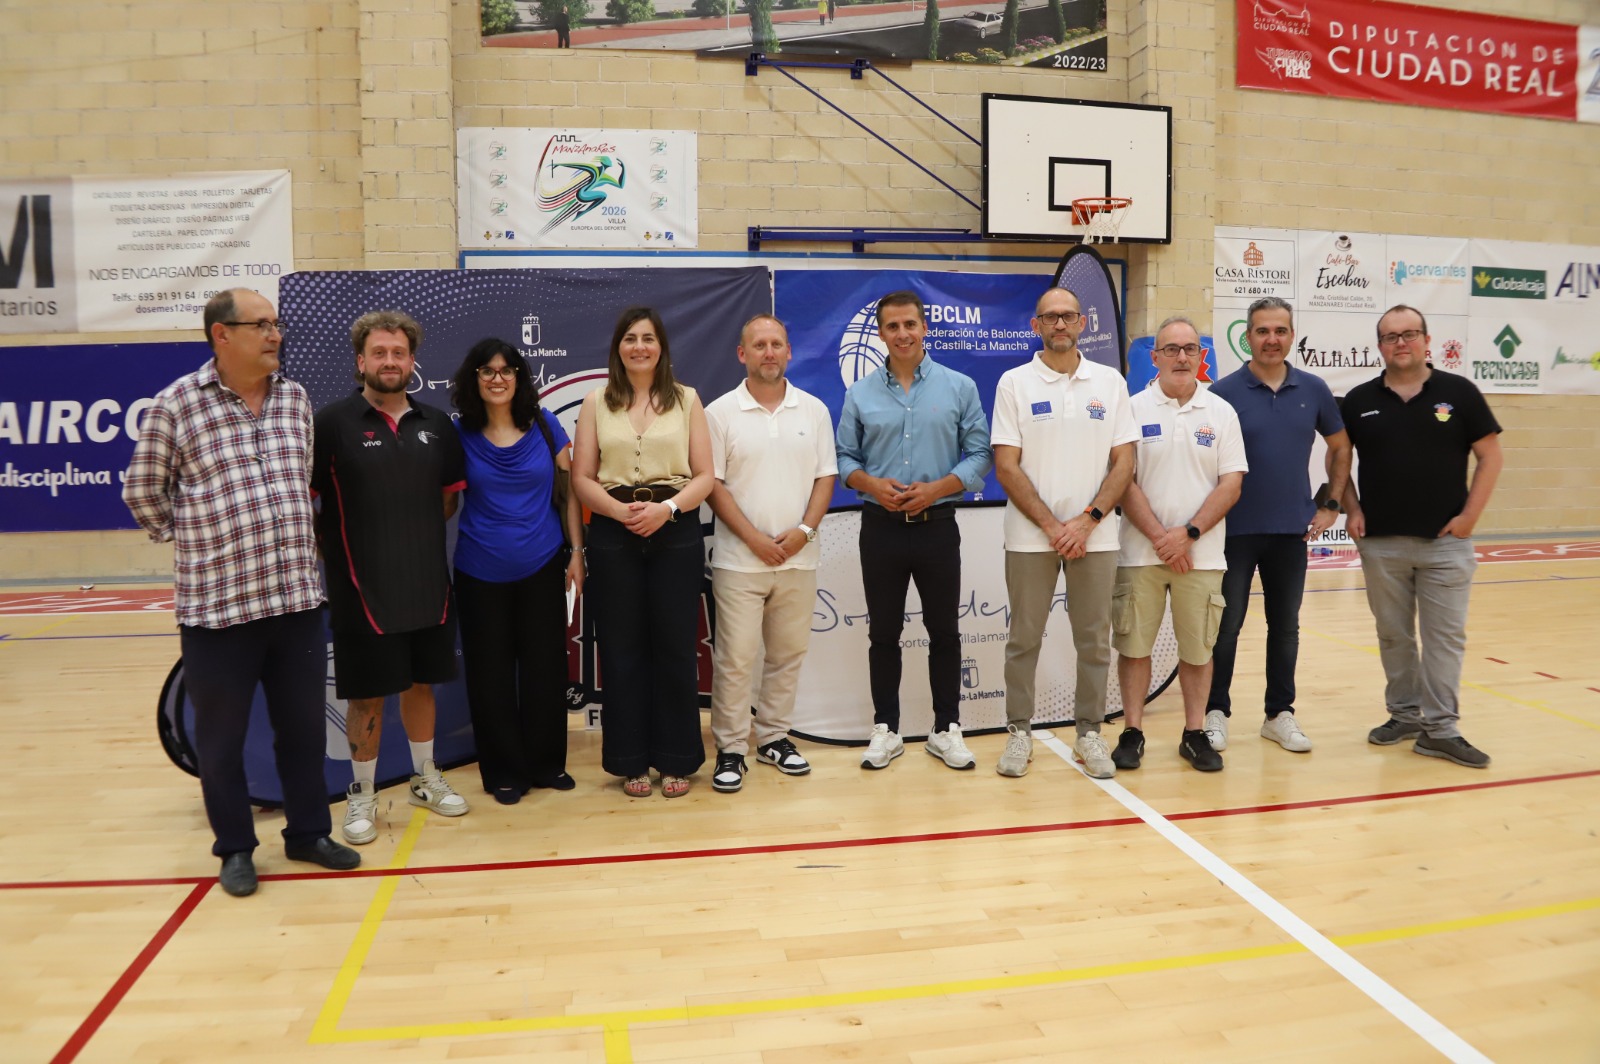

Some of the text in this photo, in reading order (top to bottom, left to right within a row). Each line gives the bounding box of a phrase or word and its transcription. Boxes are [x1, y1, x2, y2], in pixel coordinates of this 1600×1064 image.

[1254, 22, 1310, 36] CIUDAD REAL
[1532, 45, 1565, 66] DE
[1054, 54, 1107, 71] 2022/23
[1274, 57, 1312, 70] CIUDAD
[1285, 67, 1312, 80] REAL
[1327, 46, 1474, 87] CIUDAD
[1484, 62, 1565, 98] REAL
[136, 190, 169, 198] REVISTAS
[173, 189, 198, 197] LIBROS
[202, 188, 235, 197] FOLLETOS
[240, 187, 273, 196] TARJETAS
[229, 201, 255, 209] DIGITAL
[601, 206, 627, 216] 2026
[235, 213, 250, 221] WEB
[177, 229, 199, 237] PAPEL
[200, 227, 234, 236] CONTINUO
[155, 243, 166, 251] DE
[166, 242, 206, 250] PUBLICIDAD
[211, 240, 251, 249] PACKAGING
[89, 263, 282, 281] NOS ENCARGAMOS DE TODO
[1316, 264, 1370, 290] Escobar
[1408, 264, 1467, 278] cervantes
[1248, 287, 1261, 295] 680
[1491, 276, 1546, 295] Globalcaja
[138, 292, 155, 301] 695
[157, 292, 168, 301] 91
[171, 291, 182, 300] 91
[184, 290, 196, 299] 64
[1309, 301, 1344, 309] MANZANARES
[926, 327, 1042, 339] ederación de Baloncest
[934, 339, 987, 351] Castilla-La
[989, 341, 1029, 351] Mancha
[1472, 360, 1540, 380] TECNOCASA
[0, 461, 111, 497] disciplina
